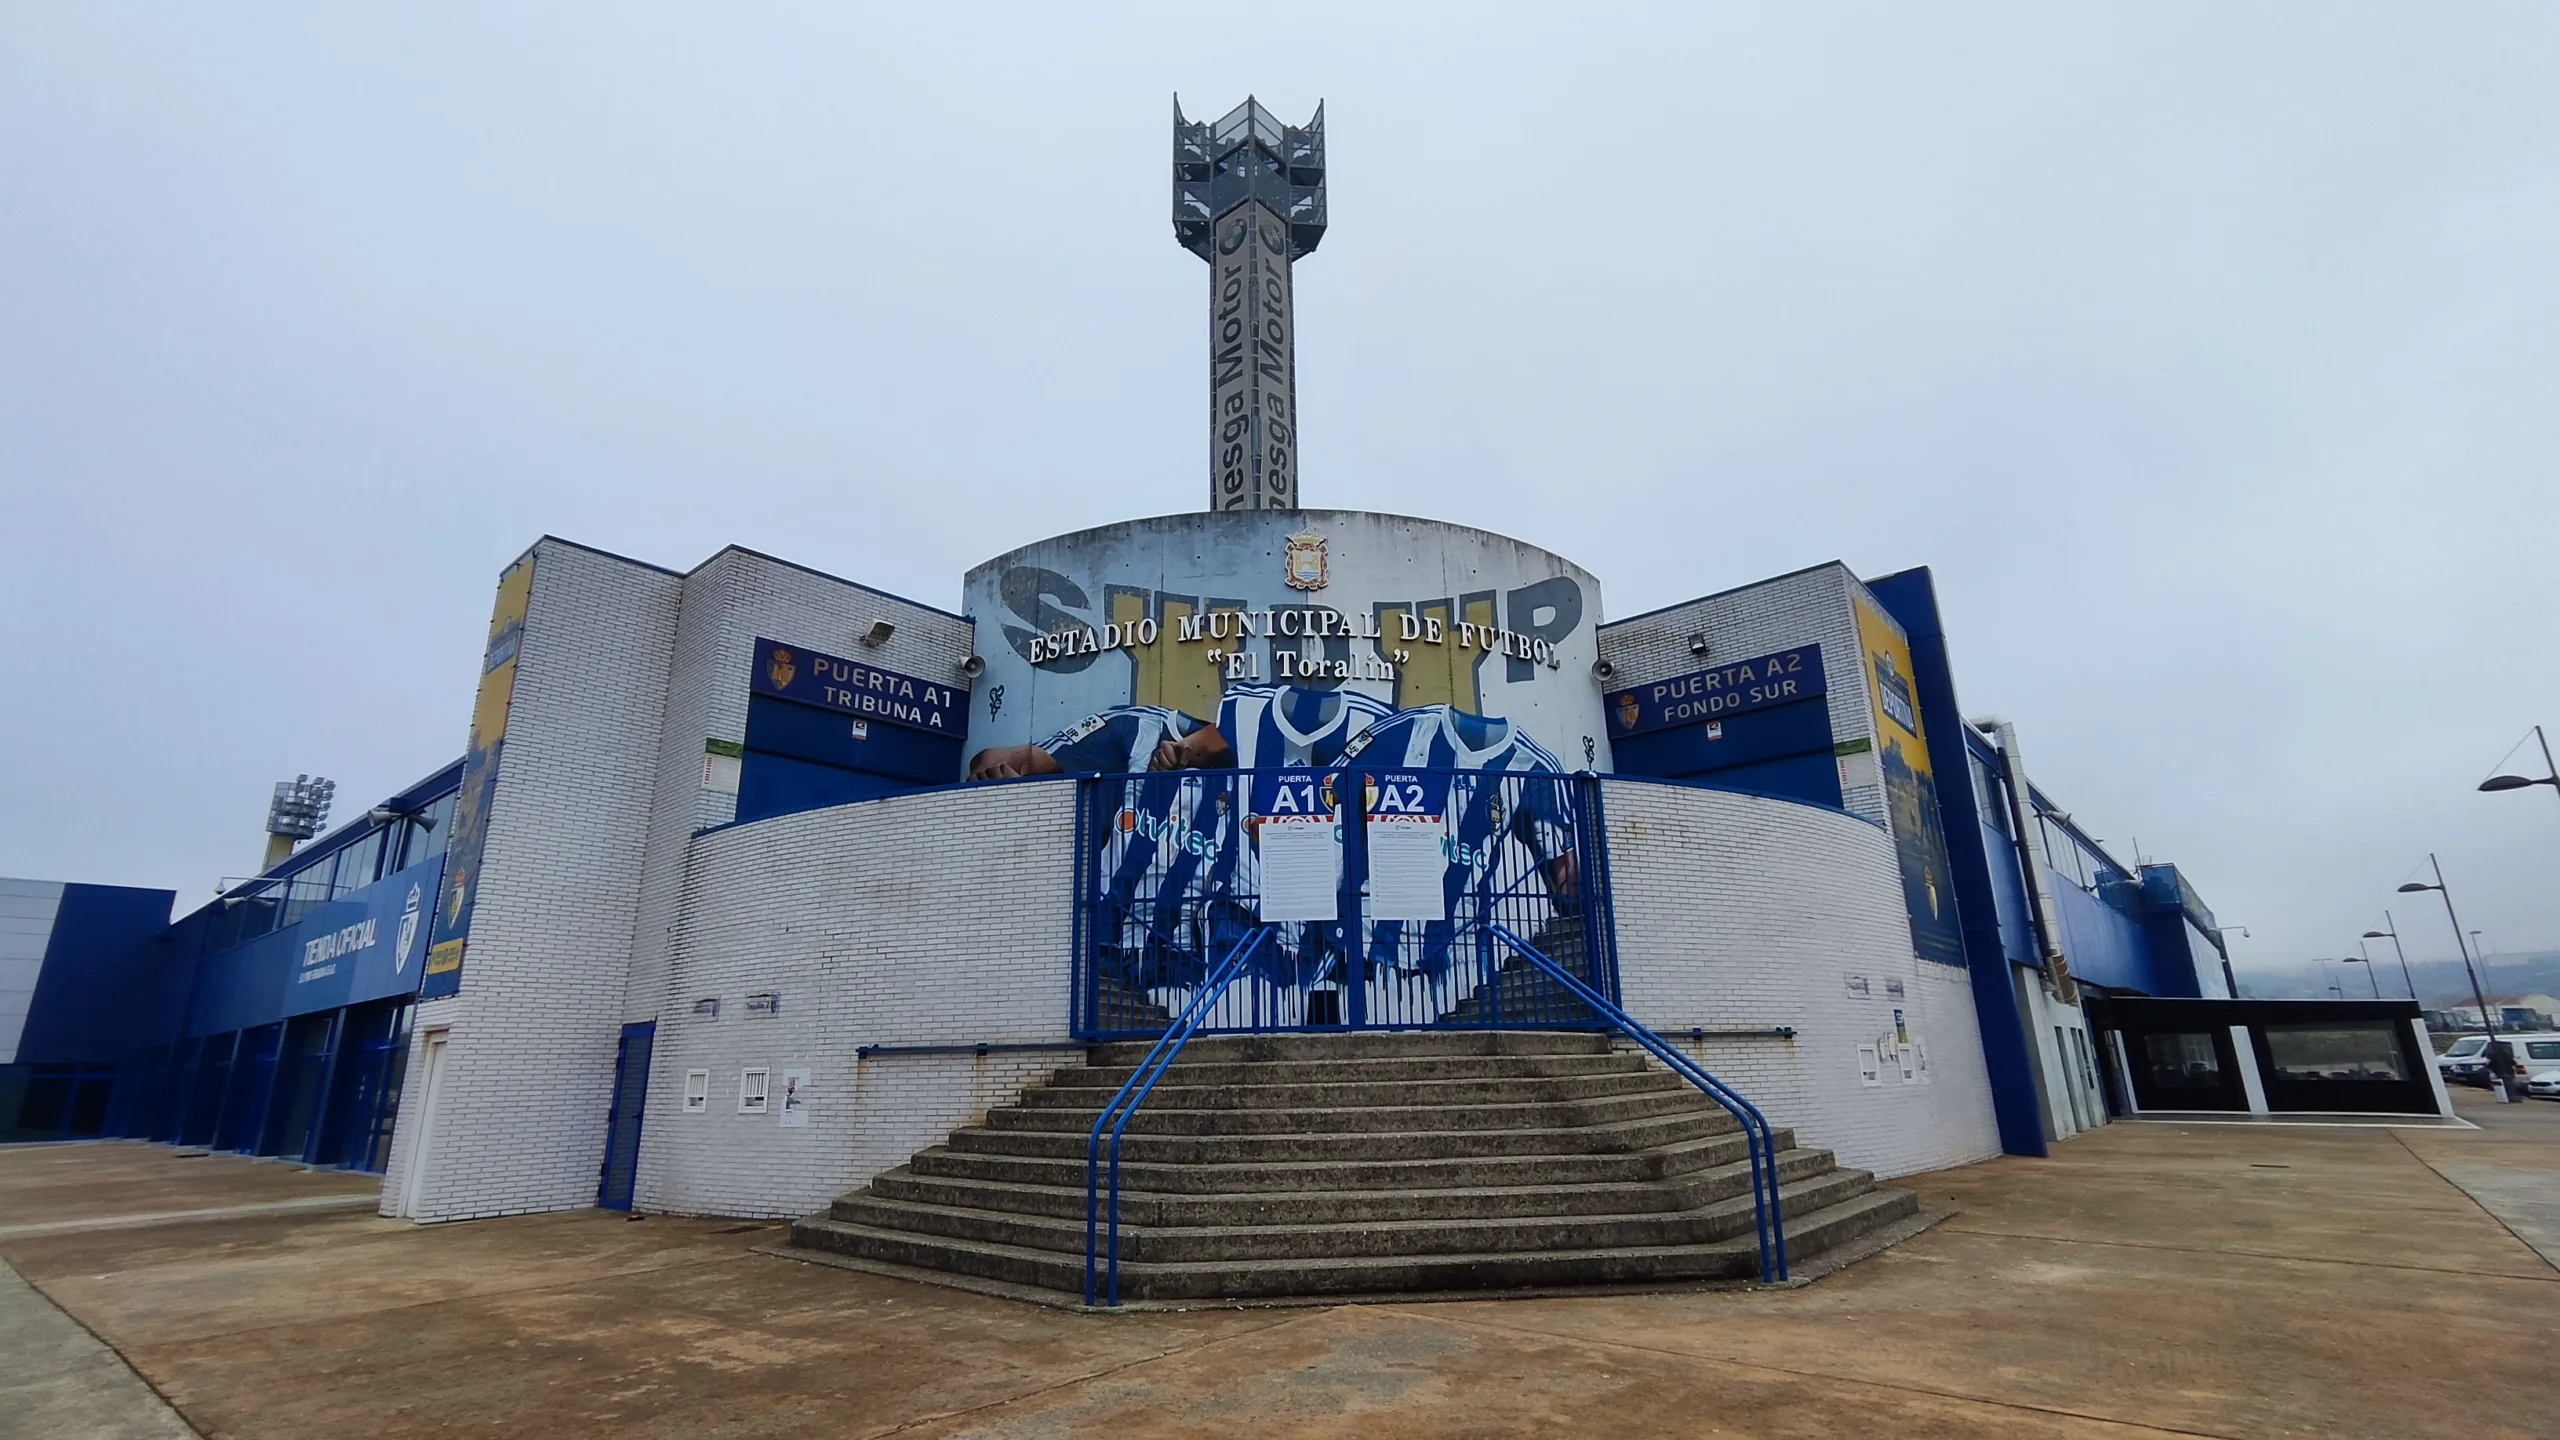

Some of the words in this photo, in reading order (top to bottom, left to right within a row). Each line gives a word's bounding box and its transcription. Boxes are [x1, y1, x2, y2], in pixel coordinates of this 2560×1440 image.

[1217, 264, 1243, 388] Motor
[1260, 257, 1284, 386] Motor
[1029, 617, 1159, 664] ESTADIO
[1177, 609, 1382, 642] MUNICIPAL
[1399, 613, 1443, 644] DE
[1459, 621, 1561, 671] FUTBOL
[813, 657, 914, 699] PUERTA
[923, 687, 951, 708] A1
[1653, 665, 1756, 703] PUERTA
[1766, 653, 1803, 678] A2
[1663, 691, 1741, 722] FONDO
[1750, 679, 1798, 703] SUR
[823, 685, 923, 723] TRIBUNA
[929, 711, 943, 728] A
[1271, 784, 1315, 813] A1
[1278, 775, 1313, 783] PUERTA
[1379, 784, 1425, 812] A2
[1385, 774, 1418, 783] PUERTA
[303, 932, 337, 967] TIENDA
[337, 918, 377, 957] OFICIAL
